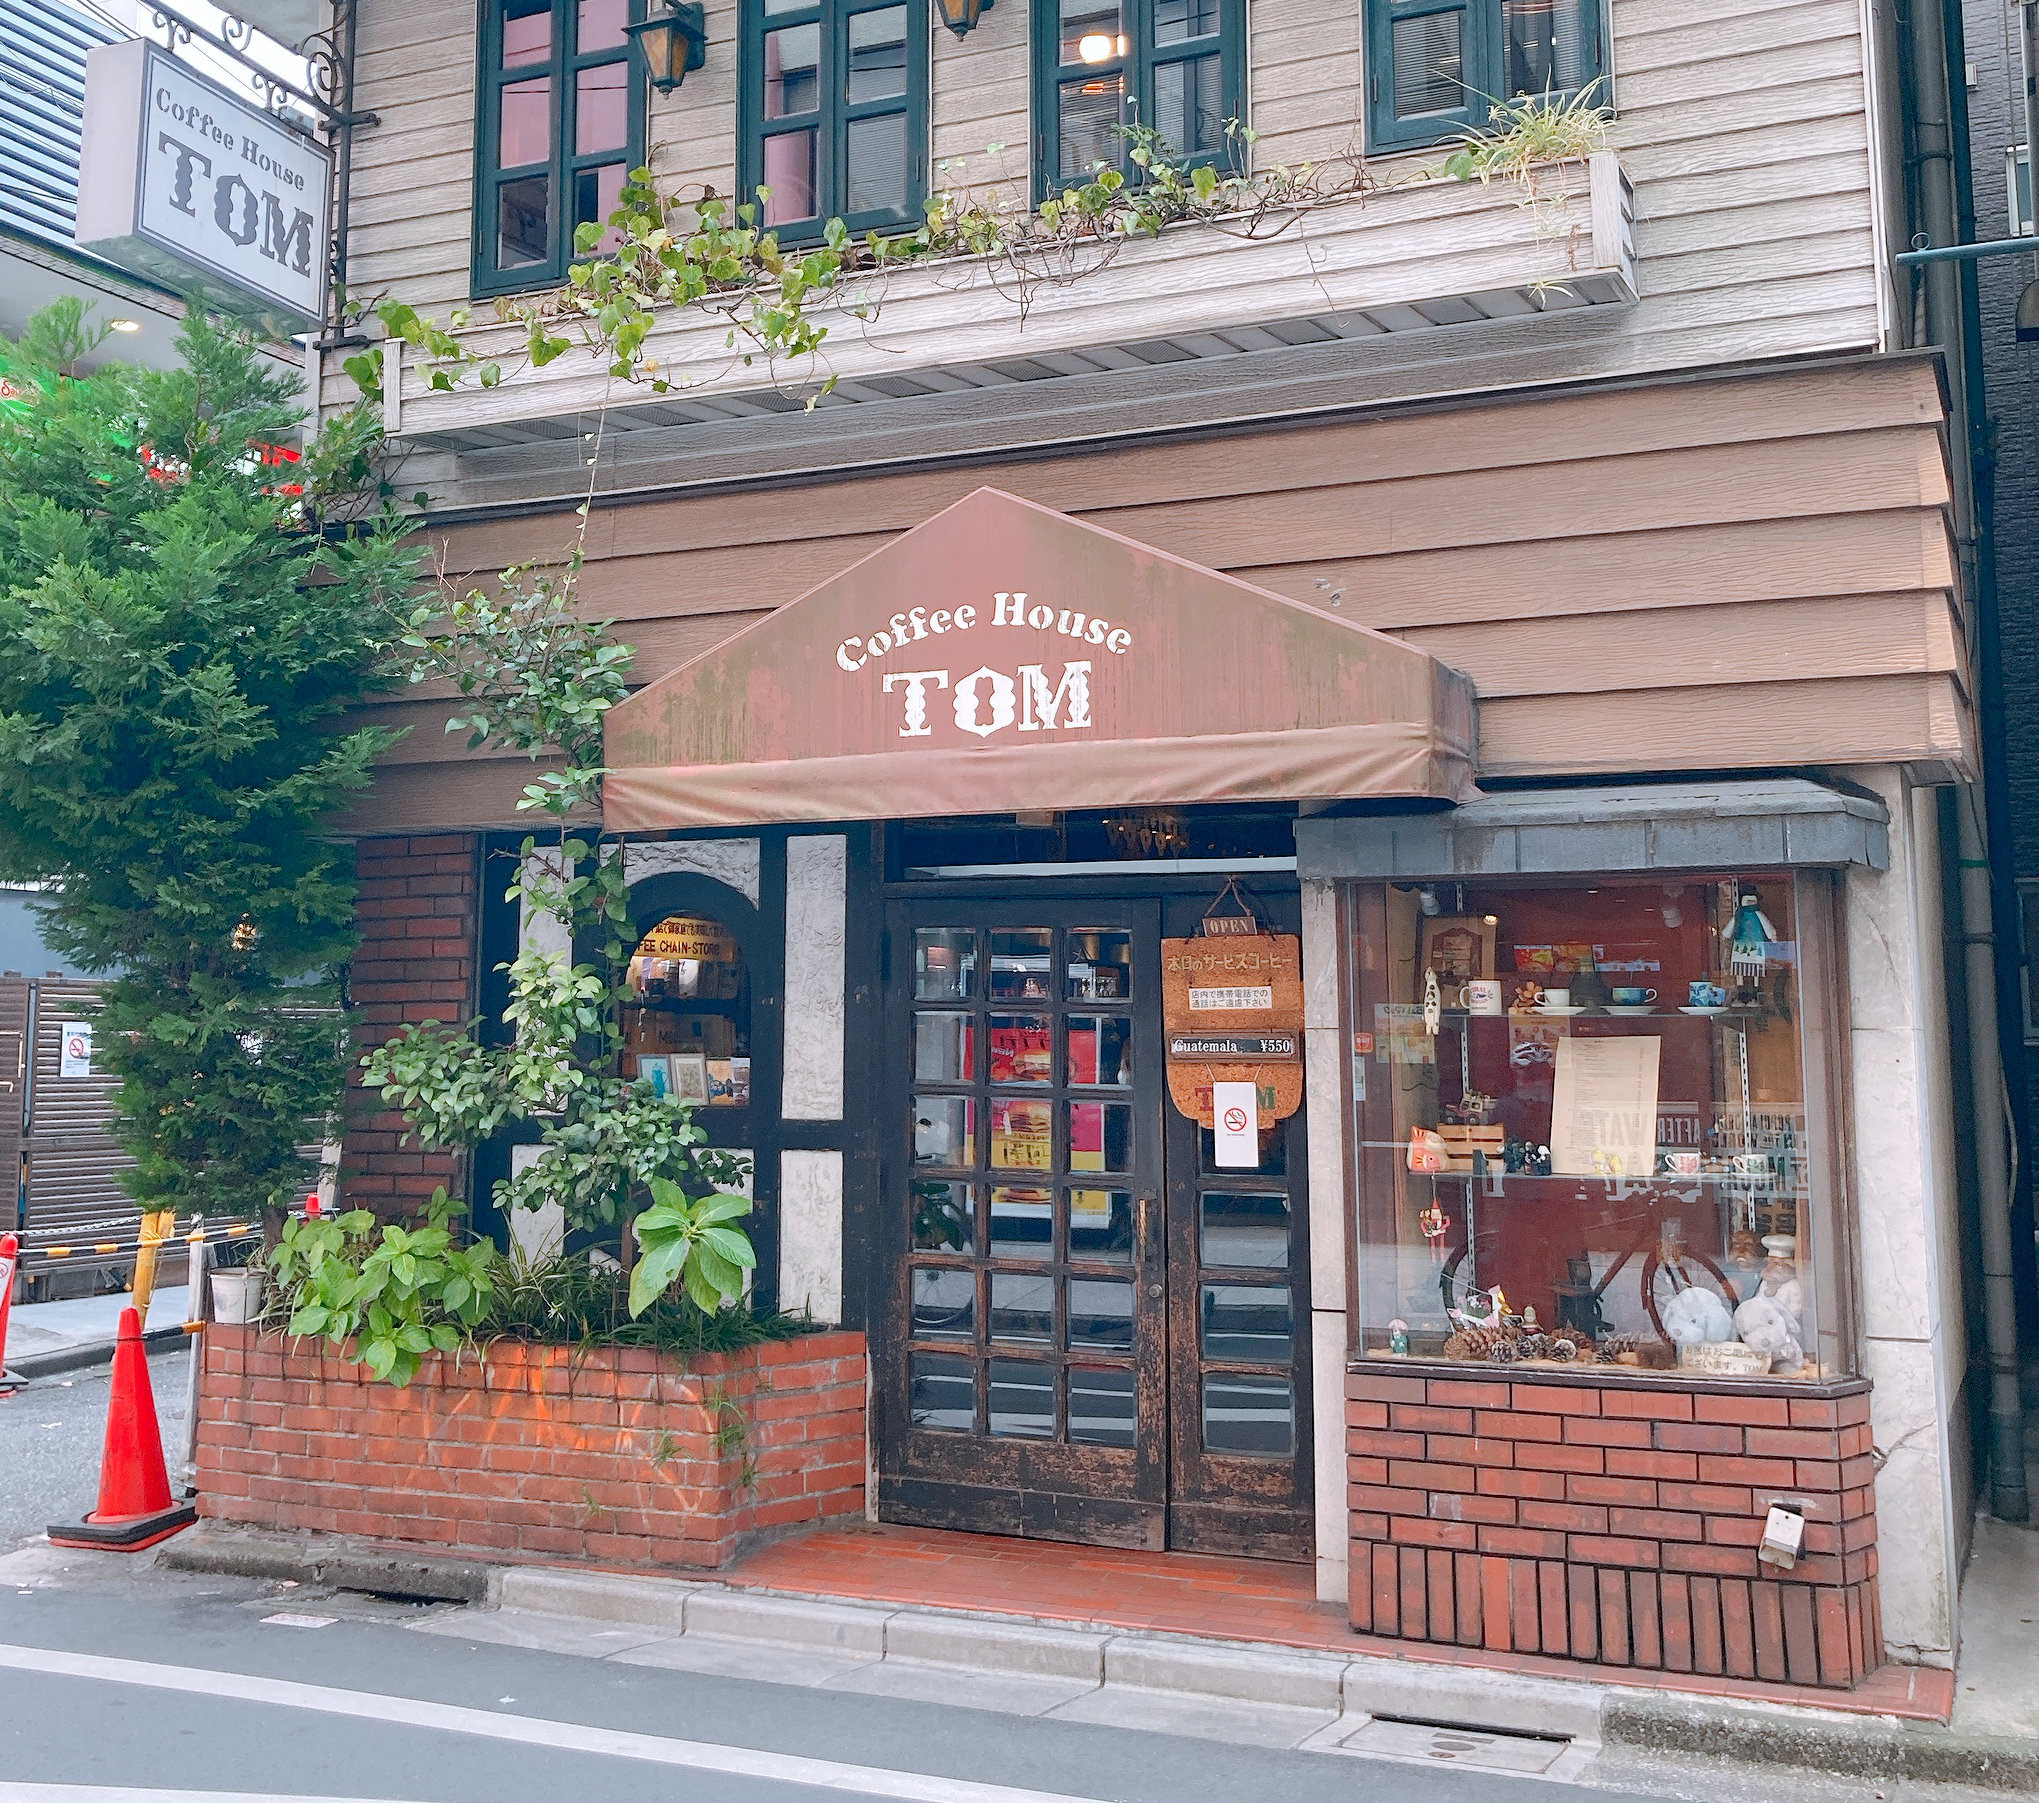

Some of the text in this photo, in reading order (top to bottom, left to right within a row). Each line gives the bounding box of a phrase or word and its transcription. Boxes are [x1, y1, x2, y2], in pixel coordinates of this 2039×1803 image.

[156, 87, 305, 191] Coffee House
[158, 130, 313, 279] TOM
[836, 592, 1132, 672] Coffee House
[882, 660, 1092, 738] TOM
[1209, 919, 1249, 934] OPEN
[1167, 952, 1293, 971] 本日のサービスコーヒー
[1191, 988, 1268, 999] 店内で携帯電話での
[1191, 999, 1267, 1009] 通話はご遠慮下さい
[1174, 1039, 1290, 1052] Guatemala ¥550
[1195, 1086, 1275, 1111] TM
